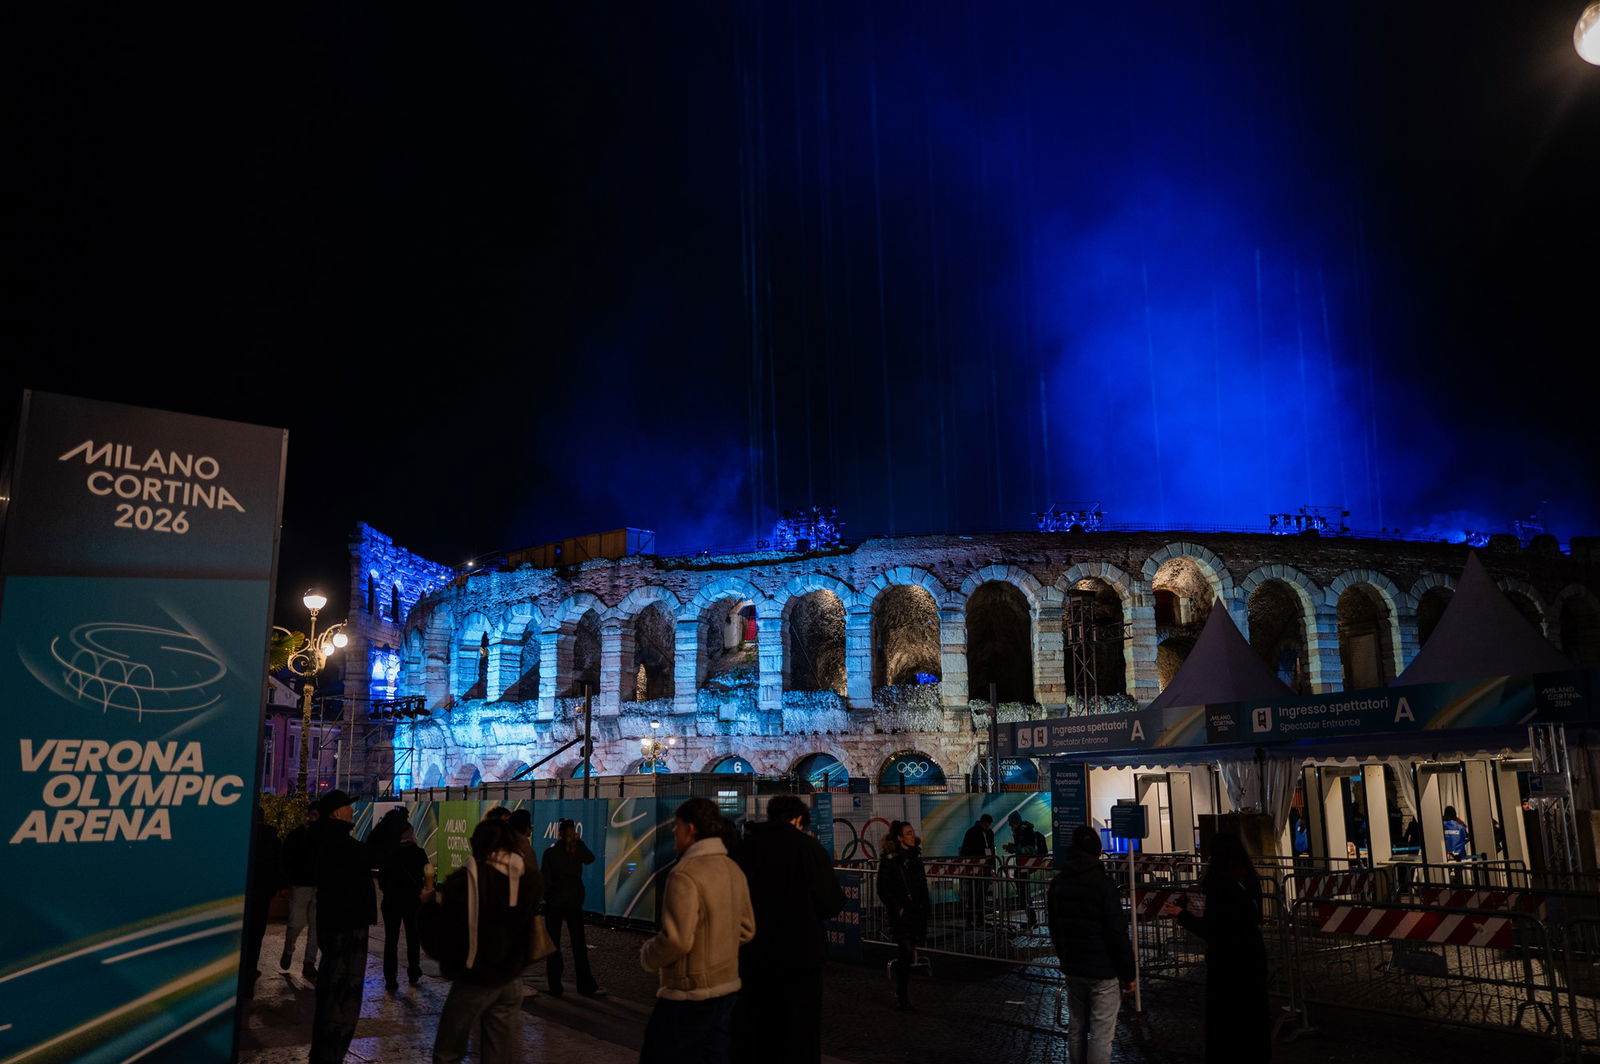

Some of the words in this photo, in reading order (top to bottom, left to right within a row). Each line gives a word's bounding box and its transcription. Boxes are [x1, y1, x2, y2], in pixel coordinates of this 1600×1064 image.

[59, 440, 220, 480] MILANO
[87, 471, 246, 513] CORTINA
[113, 503, 190, 535] 2026
[1278, 704, 1327, 720] Ingresso
[1329, 696, 1389, 716] spettatori
[1393, 696, 1416, 724] A
[1052, 723, 1086, 737] Ingresso
[1087, 719, 1128, 734] spettatori
[1130, 719, 1146, 742] A
[1279, 720, 1320, 733] Spectator
[1321, 718, 1361, 729] Entrance
[21, 739, 203, 772] VERONA
[1052, 737, 1080, 748] Spectator
[1081, 736, 1109, 745] Entrance
[733, 762, 742, 774] 6
[43, 774, 243, 808] OLYMPIC
[10, 808, 171, 844] ARENA
[444, 818, 467, 834] MILANO
[447, 836, 472, 852] CORTINA
